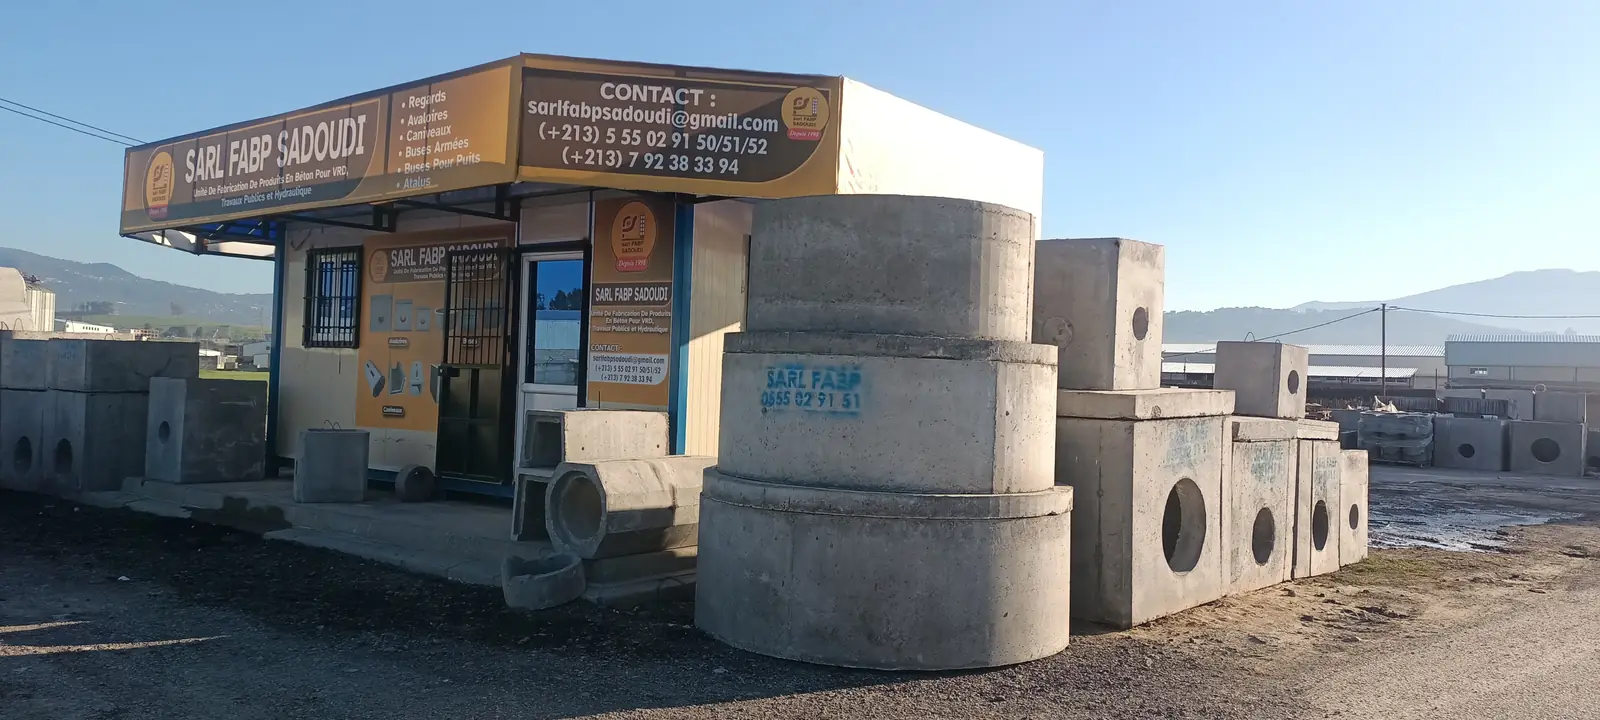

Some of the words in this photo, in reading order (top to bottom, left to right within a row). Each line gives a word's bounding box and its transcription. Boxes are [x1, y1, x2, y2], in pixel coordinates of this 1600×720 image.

[408, 90, 446, 108] Regards
[600, 82, 704, 105] CONTACT
[407, 109, 448, 126] Avaloires
[528, 100, 778, 132] sarlfabpsadoudi@gmail.com
[406, 125, 452, 141] Caniveaux
[539, 122, 600, 144] (+213)
[606, 128, 616, 144] 5
[620, 130, 641, 146] 55
[646, 131, 666, 148] 02
[671, 132, 689, 149] 91
[696, 134, 768, 154] 50/51/52
[185, 144, 224, 184] SARL
[228, 134, 272, 177] FABP
[276, 115, 366, 168] SADOUDI
[406, 145, 432, 158] Buses
[434, 137, 469, 153] Armées
[404, 162, 430, 174] Buses
[433, 158, 454, 170] Pour
[456, 152, 480, 166] Puits
[562, 146, 622, 168] (+213)
[628, 152, 639, 168] 7
[644, 153, 664, 170] 92
[668, 154, 688, 172] 38
[694, 156, 714, 173] 33
[718, 158, 739, 174] 94
[208, 186, 216, 196] De
[217, 180, 248, 194] Fabrication
[250, 180, 258, 189] De
[259, 176, 284, 188] Produits
[285, 174, 294, 183] En
[295, 171, 314, 182] Béton
[315, 169, 330, 179] Pour
[332, 166, 348, 176] VRD,
[403, 176, 431, 190] Atalus
[221, 198, 242, 208] Travaux
[243, 194, 266, 204] Publics
[266, 192, 274, 200] et
[274, 186, 312, 201] Hydraulique
[391, 248, 416, 268] SARL
[420, 246, 446, 265] FABP
[596, 288, 613, 301] SARL
[614, 287, 632, 301] FABP
[634, 286, 668, 300] SADOUDI
[766, 370, 806, 389] SARL
[795, 392, 812, 407] 02
[818, 392, 833, 408] 91
[842, 392, 860, 408] 51
